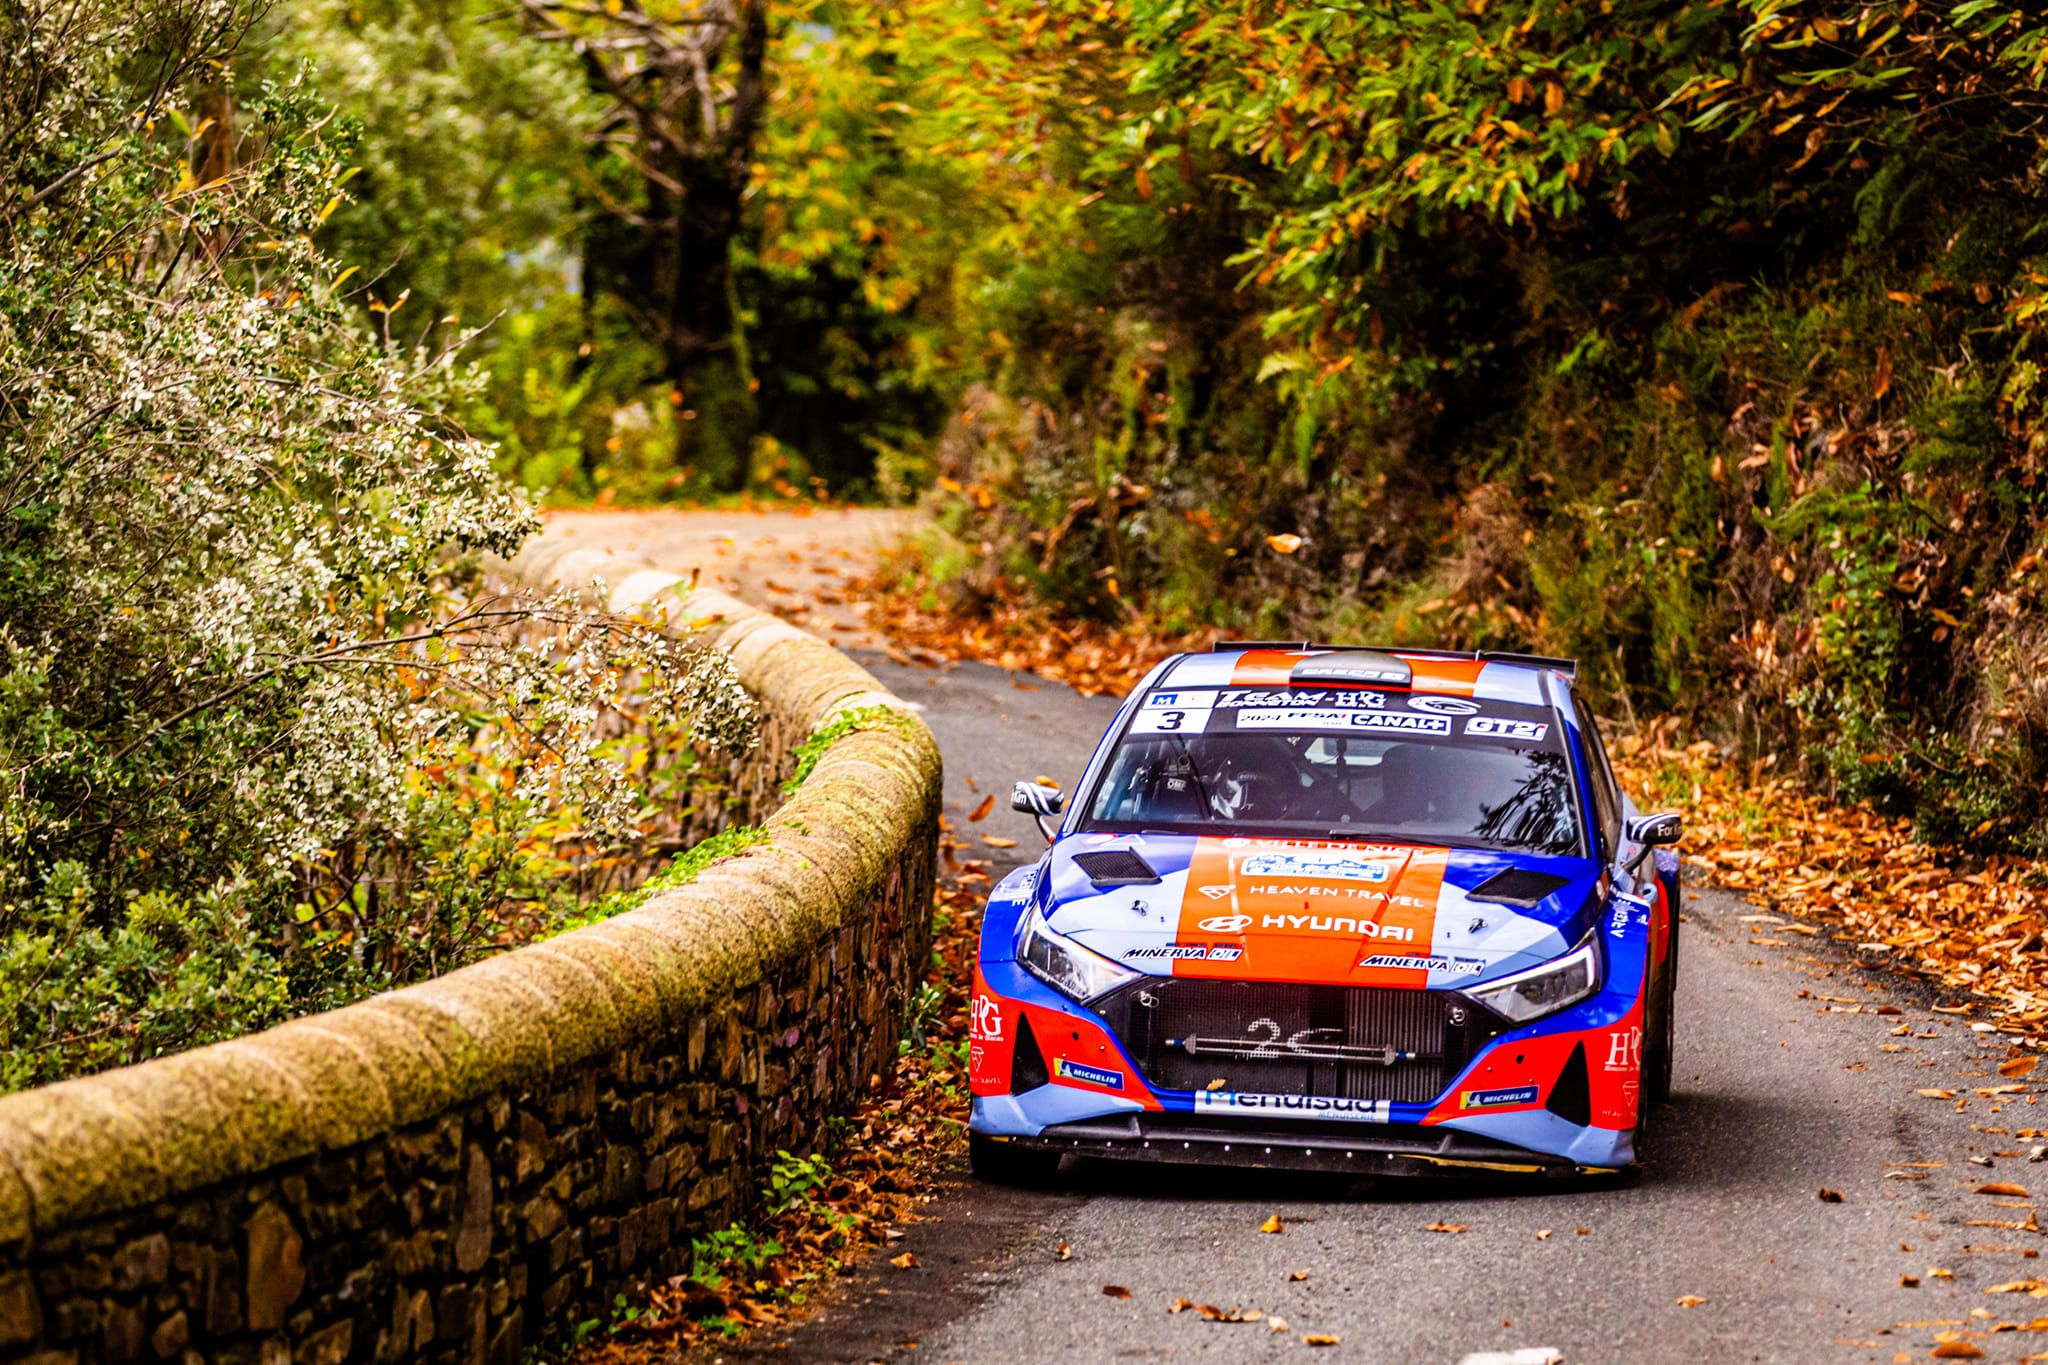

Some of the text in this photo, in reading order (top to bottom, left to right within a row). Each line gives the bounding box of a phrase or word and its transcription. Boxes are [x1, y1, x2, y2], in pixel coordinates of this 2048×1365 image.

[1156, 711, 1186, 731] 3
[1353, 714, 1446, 731] CANAL+
[1657, 823, 1673, 837] For
[1250, 884, 1425, 908] HEAVEN TRAVEL
[1262, 914, 1414, 942] HYUNDAI
[1124, 948, 1206, 959] MINERVA
[1364, 956, 1449, 971] MINERVA
[1073, 1068, 1118, 1085] MICHELIN
[1483, 1091, 1532, 1104] MICHELIN
